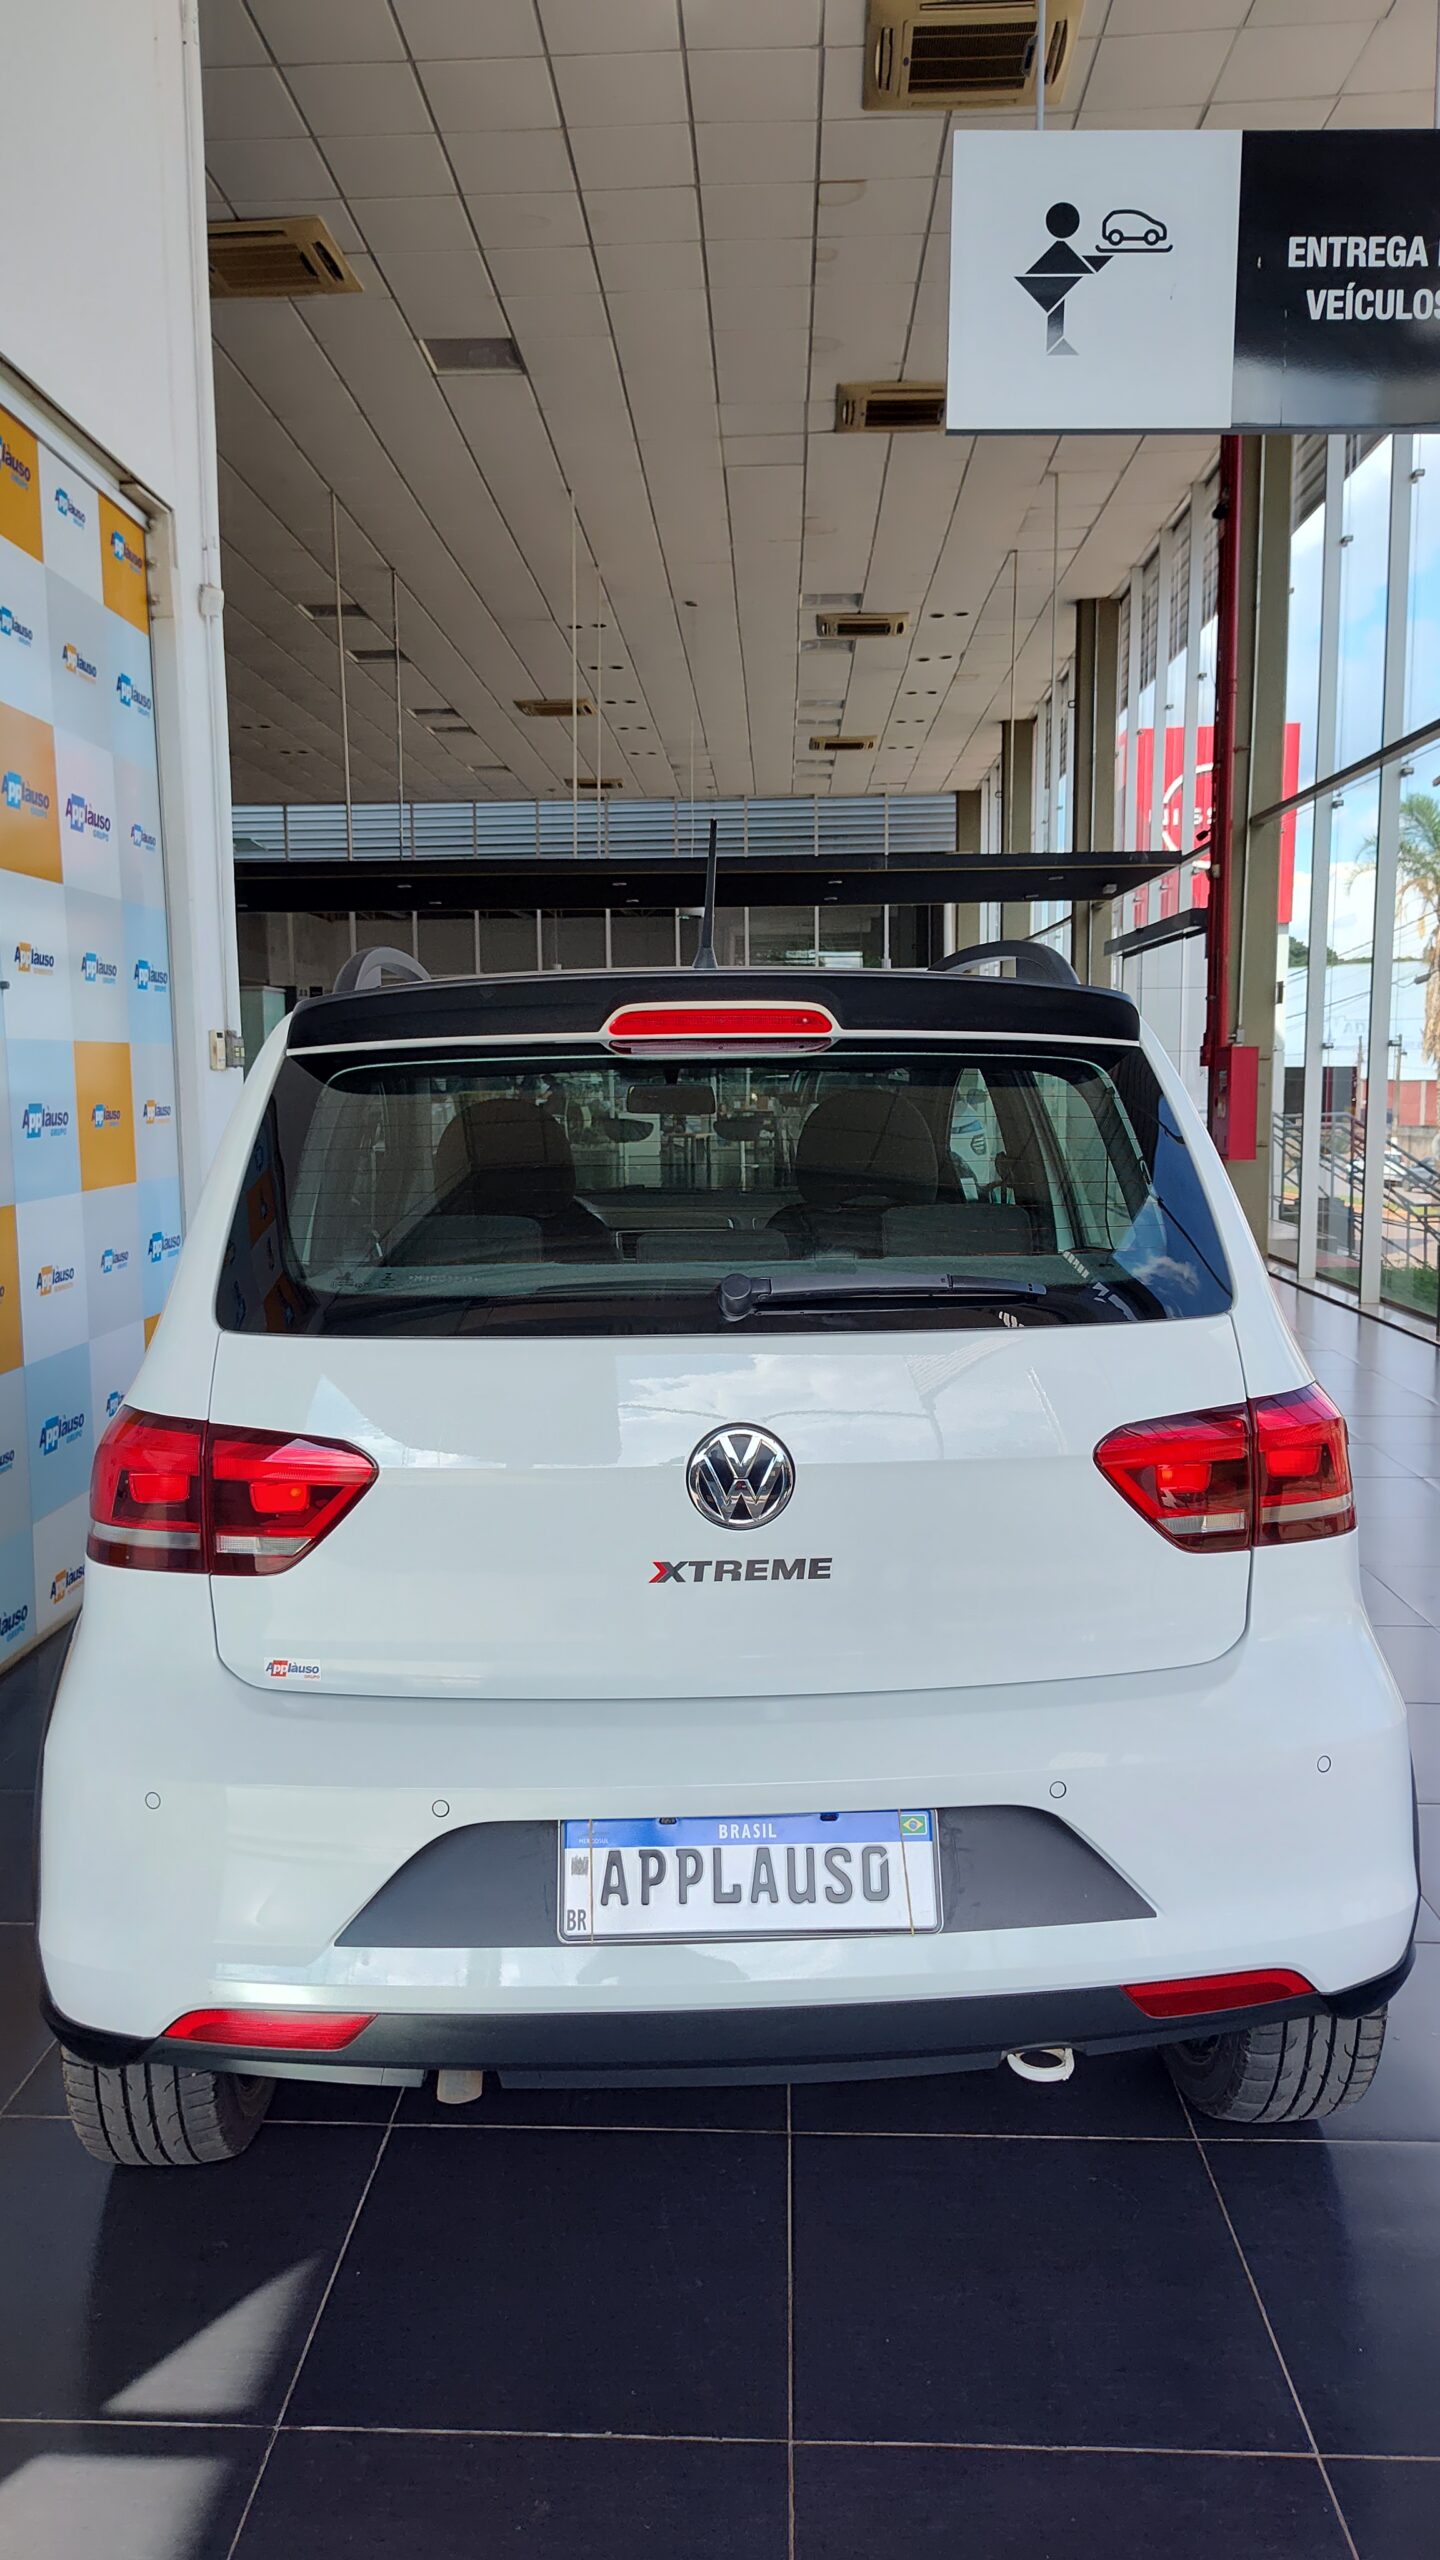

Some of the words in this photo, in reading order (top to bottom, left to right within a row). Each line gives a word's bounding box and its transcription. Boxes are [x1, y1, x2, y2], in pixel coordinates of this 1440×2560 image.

[1288, 236, 1429, 268] ENTREGA
[649, 1557, 833, 1584] XTREME
[718, 1822, 777, 1840] BRASIL
[600, 1846, 890, 1905] APPLAUSO
[566, 1908, 587, 1931] BR
